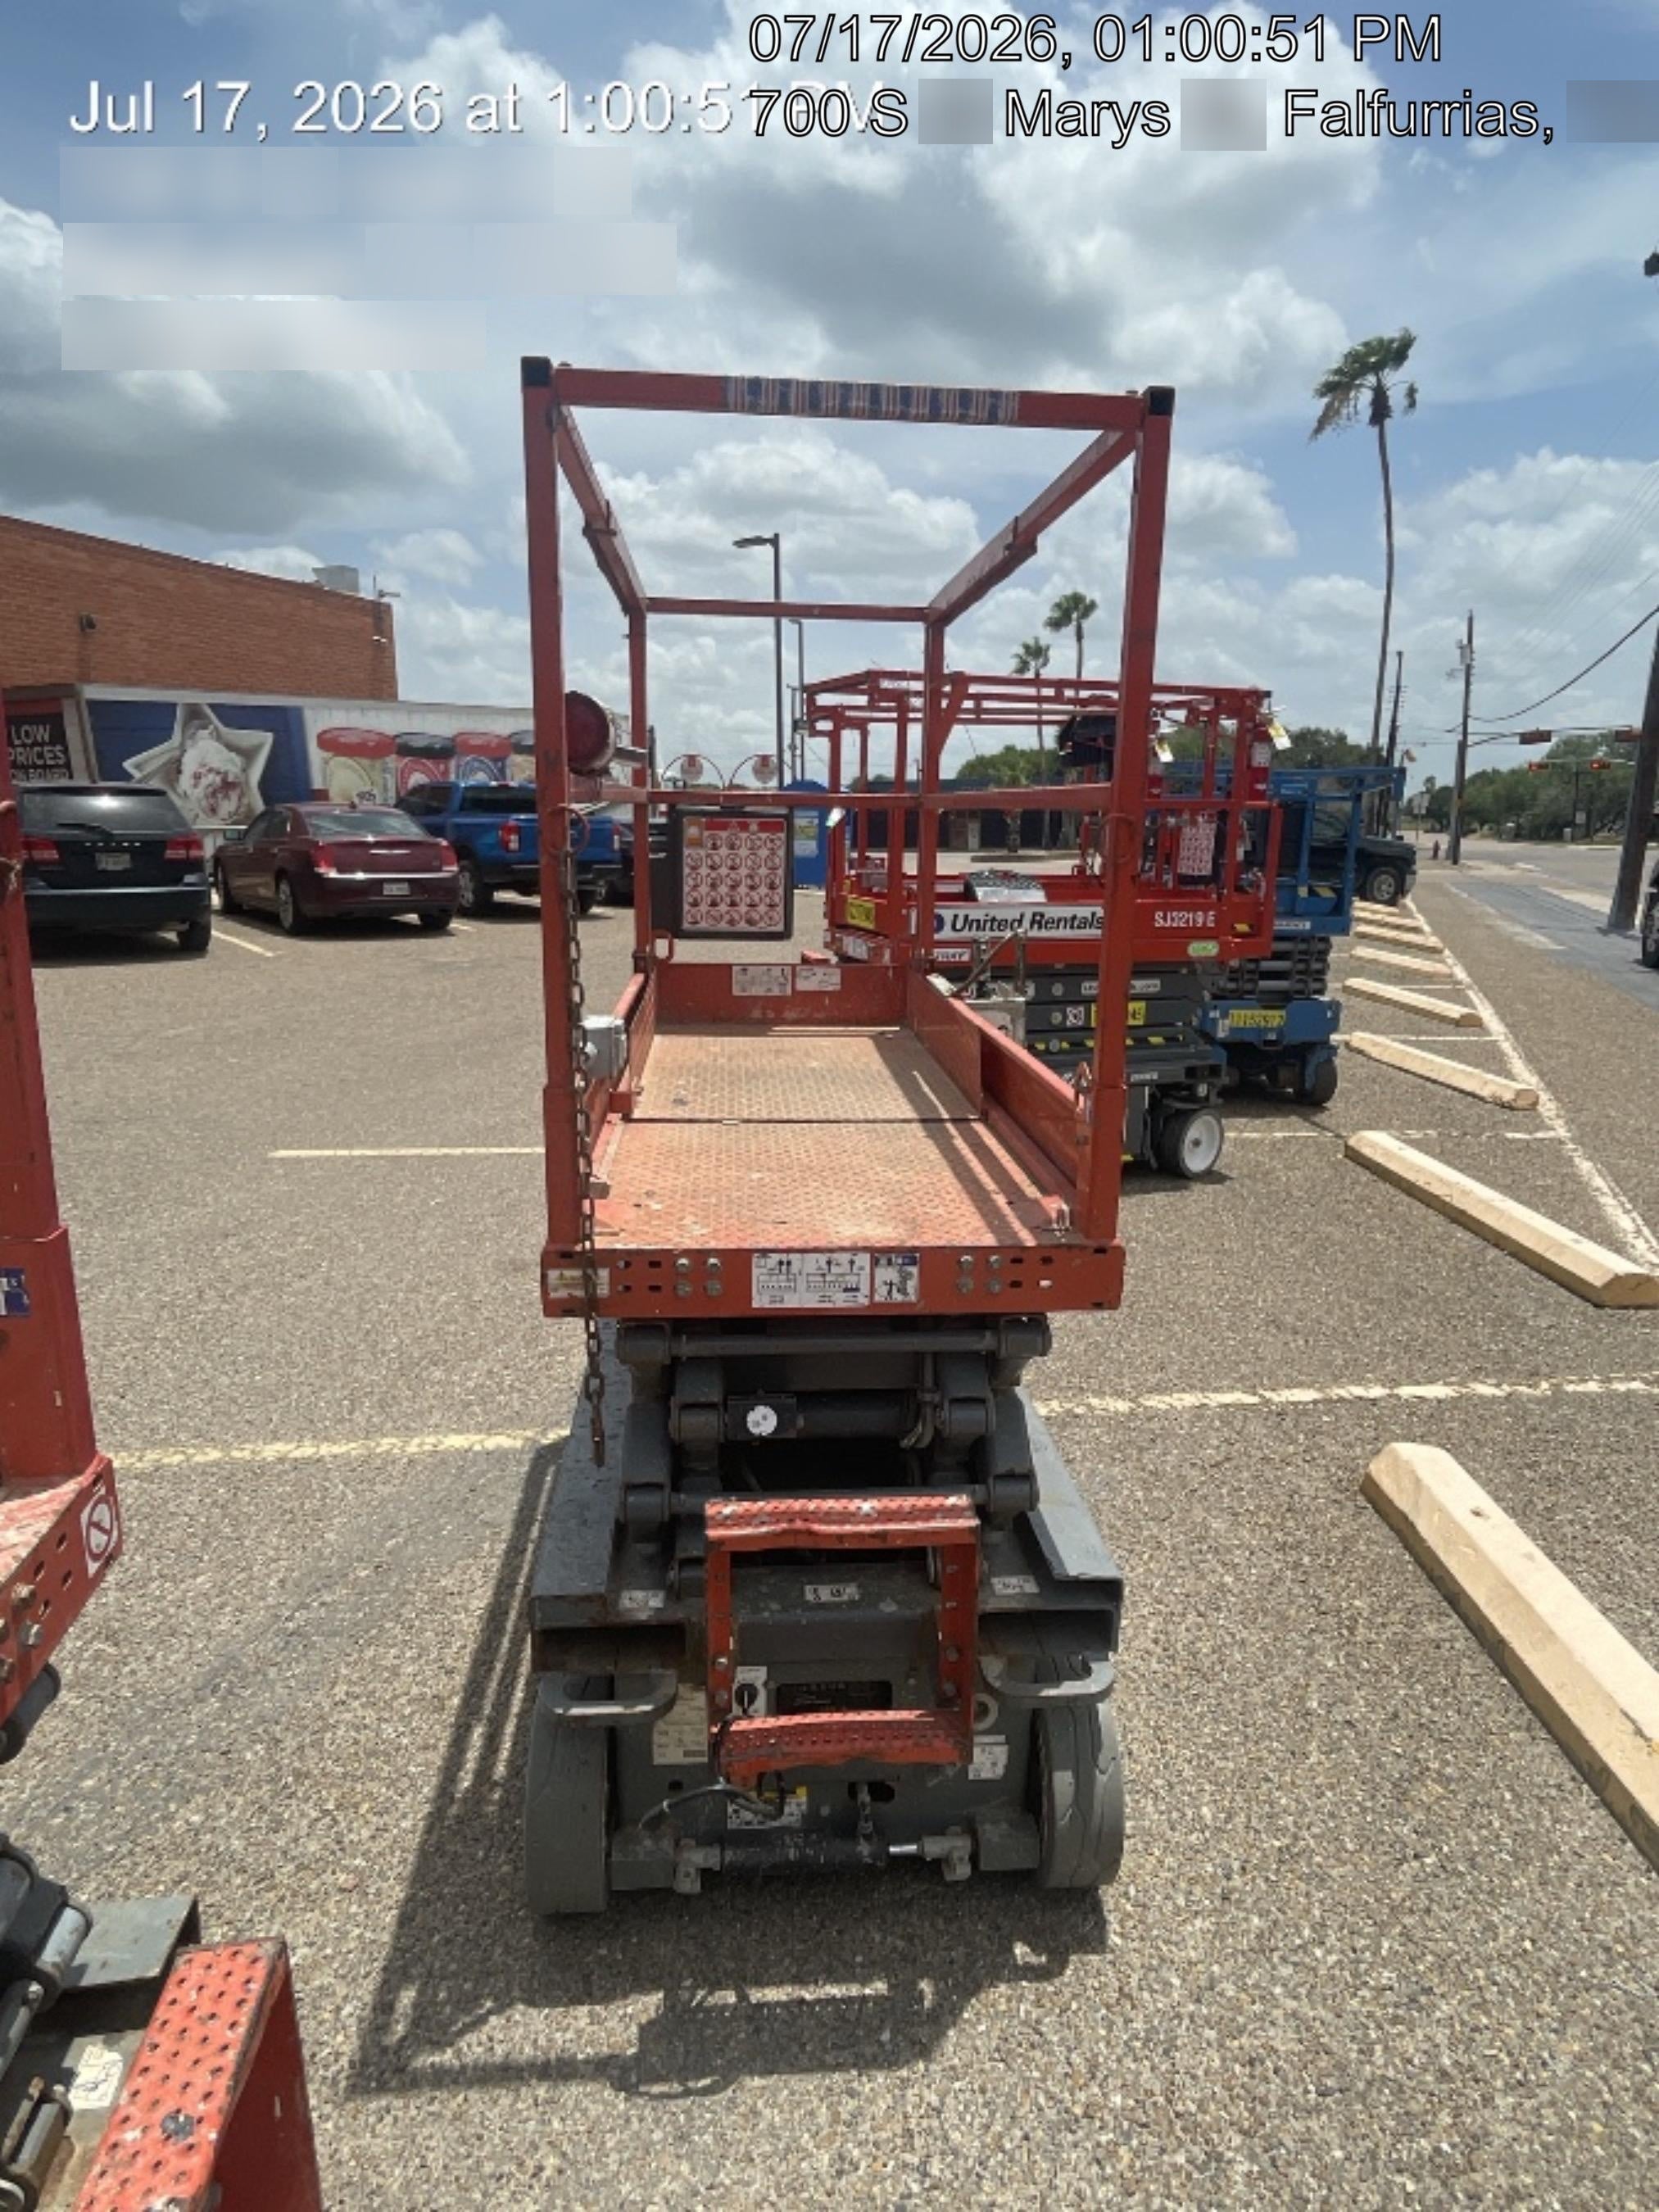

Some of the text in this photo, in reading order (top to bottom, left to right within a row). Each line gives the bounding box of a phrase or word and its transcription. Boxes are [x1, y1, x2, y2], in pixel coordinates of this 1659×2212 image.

[11, 724, 50, 745] LOW
[951, 910, 1104, 932] United Rentals
